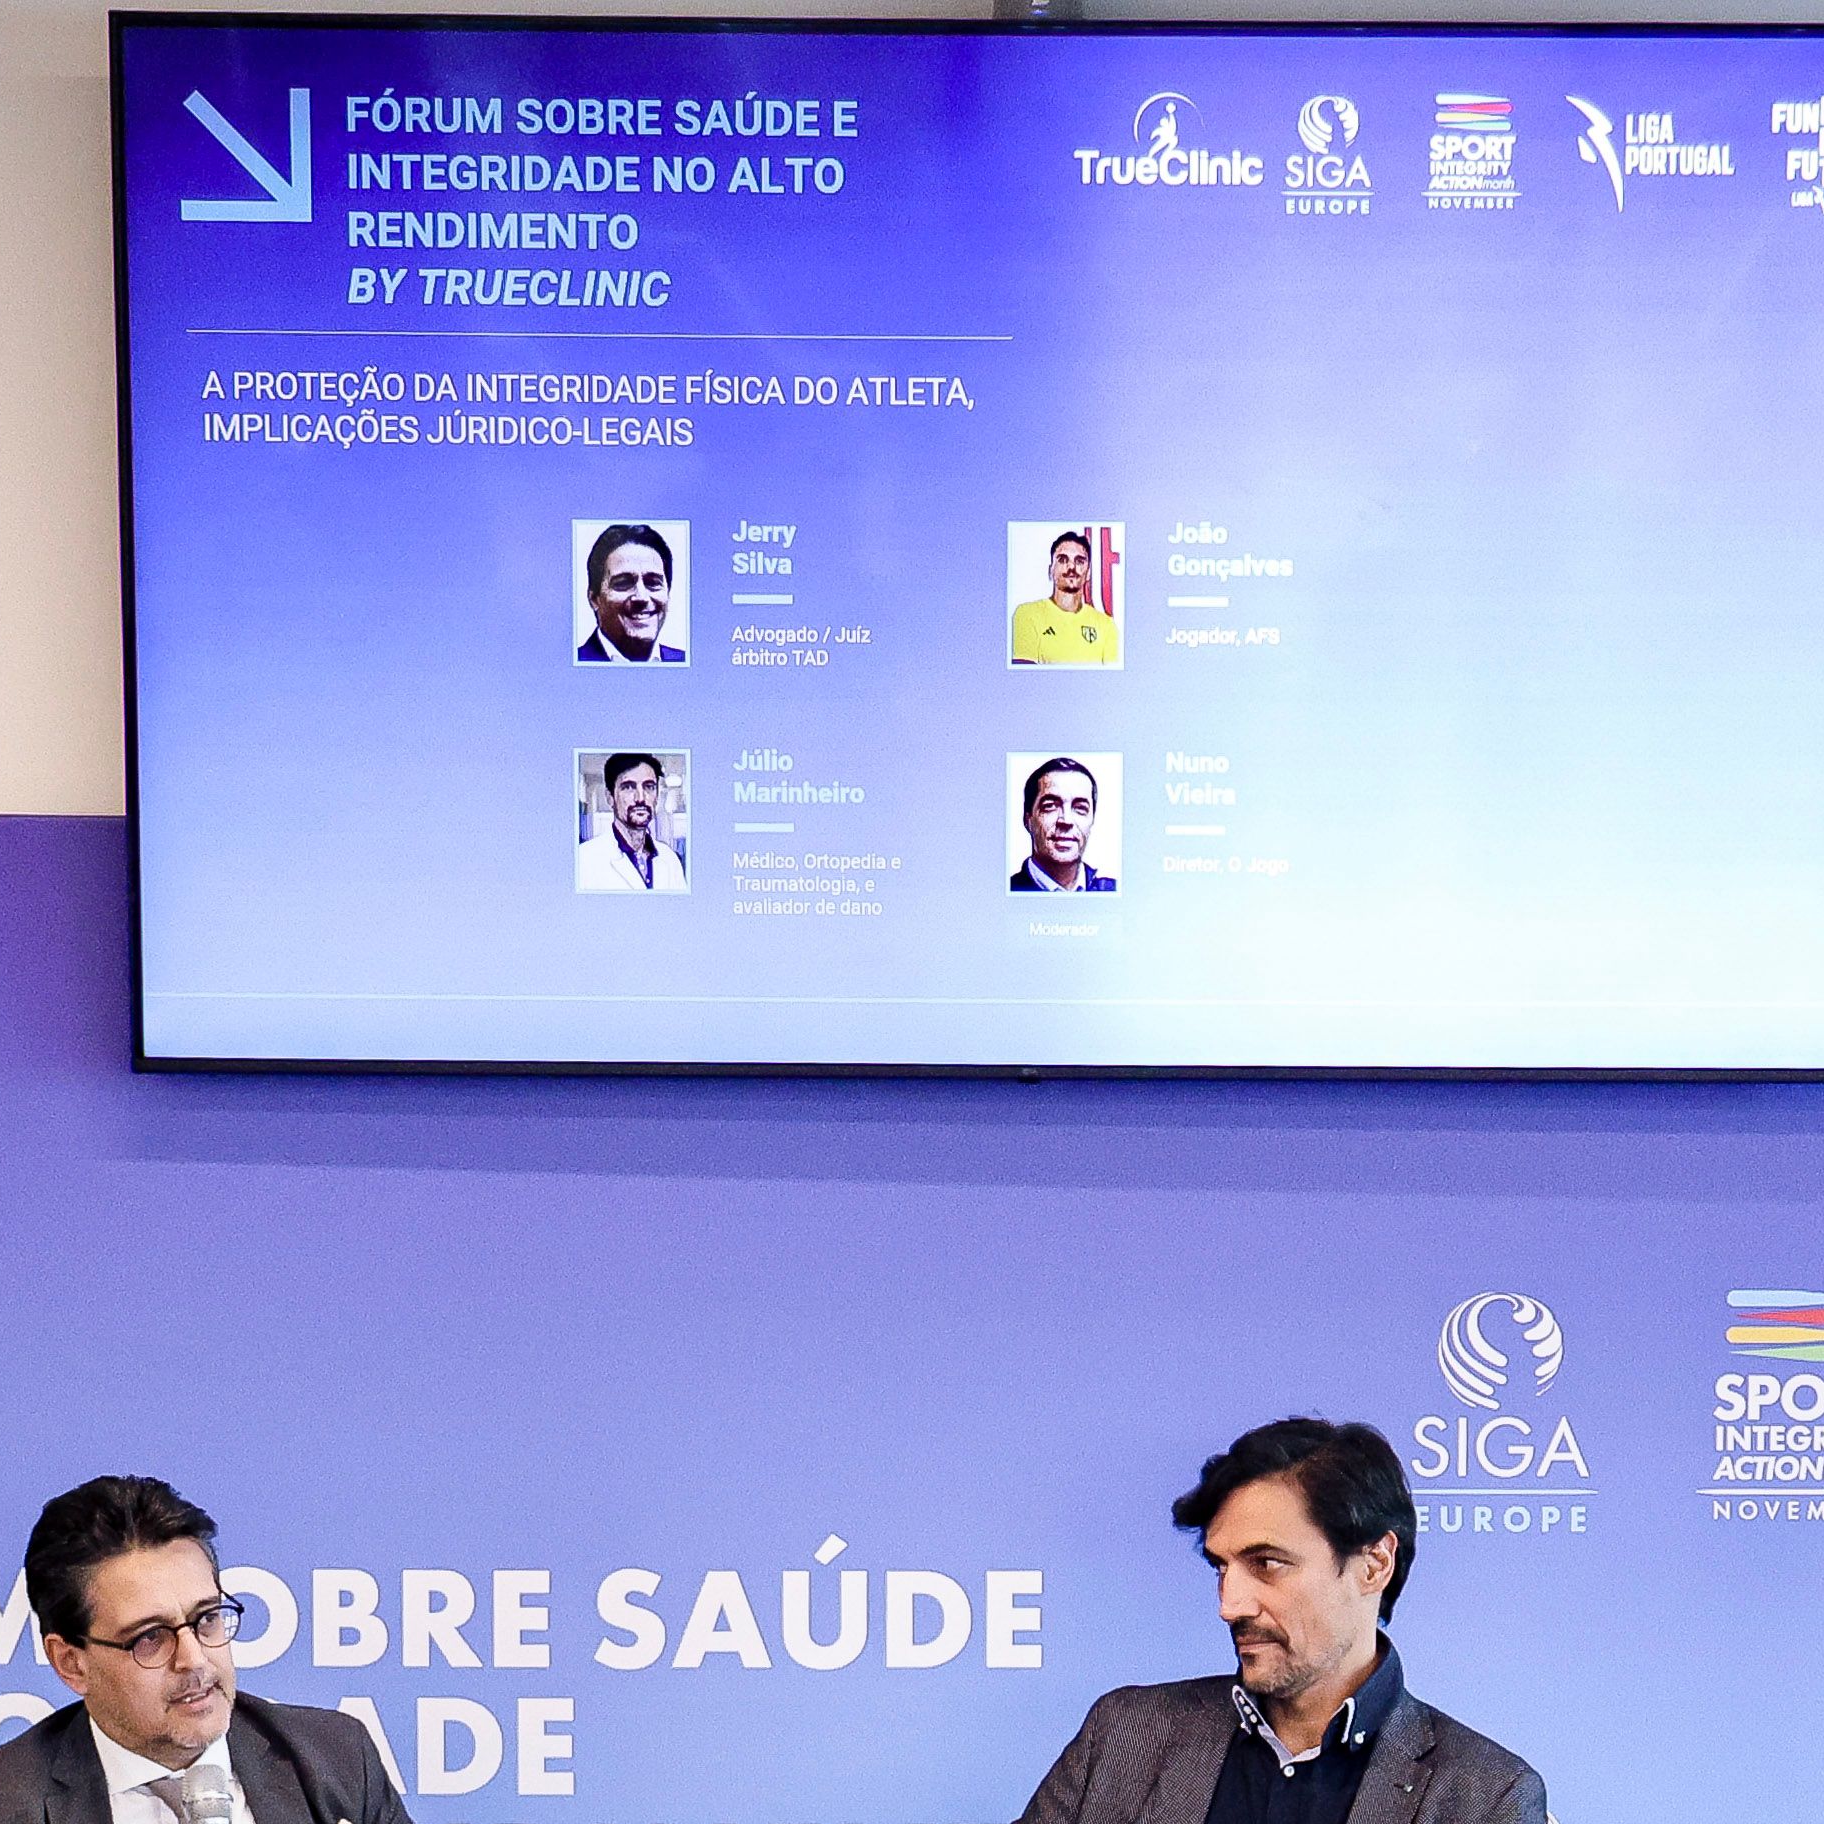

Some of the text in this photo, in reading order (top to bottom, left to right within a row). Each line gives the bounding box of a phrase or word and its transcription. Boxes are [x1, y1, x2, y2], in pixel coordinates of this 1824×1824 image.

[347, 88, 858, 137] FÓRUM SOBRE SAÚDE E
[1625, 114, 1674, 144] LIGA
[1429, 135, 1516, 161] SPORT
[1625, 145, 1735, 176] PORTUGAL
[348, 153, 845, 194] INTEGRIDADE NO ALTO
[1074, 149, 1264, 186] TrueClinic
[1285, 155, 1372, 189] SIGA
[1429, 161, 1511, 175] INTEGRITY
[1285, 199, 1370, 215] EUROPE
[1429, 198, 1514, 210] NOVEMBER
[348, 212, 639, 250] RENDIMENTO
[347, 267, 672, 307] BY TRUECLINIC
[202, 365, 976, 411] A PROTEÇÃO DA INTEGRIDADE FÍSICA DO ATLETA,
[204, 409, 694, 450] IMPLICAÇÕES JÚRIDICO-LEGAIS
[732, 520, 796, 548] Jerry
[1167, 521, 1228, 544] João
[732, 552, 792, 575] Silva
[1168, 553, 1294, 582] Gonçalves
[732, 625, 819, 646] Advogado
[732, 648, 829, 666] árbitro TAD
[733, 748, 794, 772] Júlio
[1165, 751, 1230, 774] Nuno
[733, 780, 865, 804] Marinheiro
[1165, 782, 1237, 806] Vieira
[733, 852, 902, 873] Médico, Ortopedia e
[733, 875, 875, 896] Traumatologia, e
[733, 898, 883, 916] avaliador de dano
[1411, 1416, 1590, 1478] SIGA
[1415, 1505, 1588, 1533] EUROPE
[219, 1566, 552, 1670] OBRE
[593, 1533, 1045, 1671] SAÚDE
